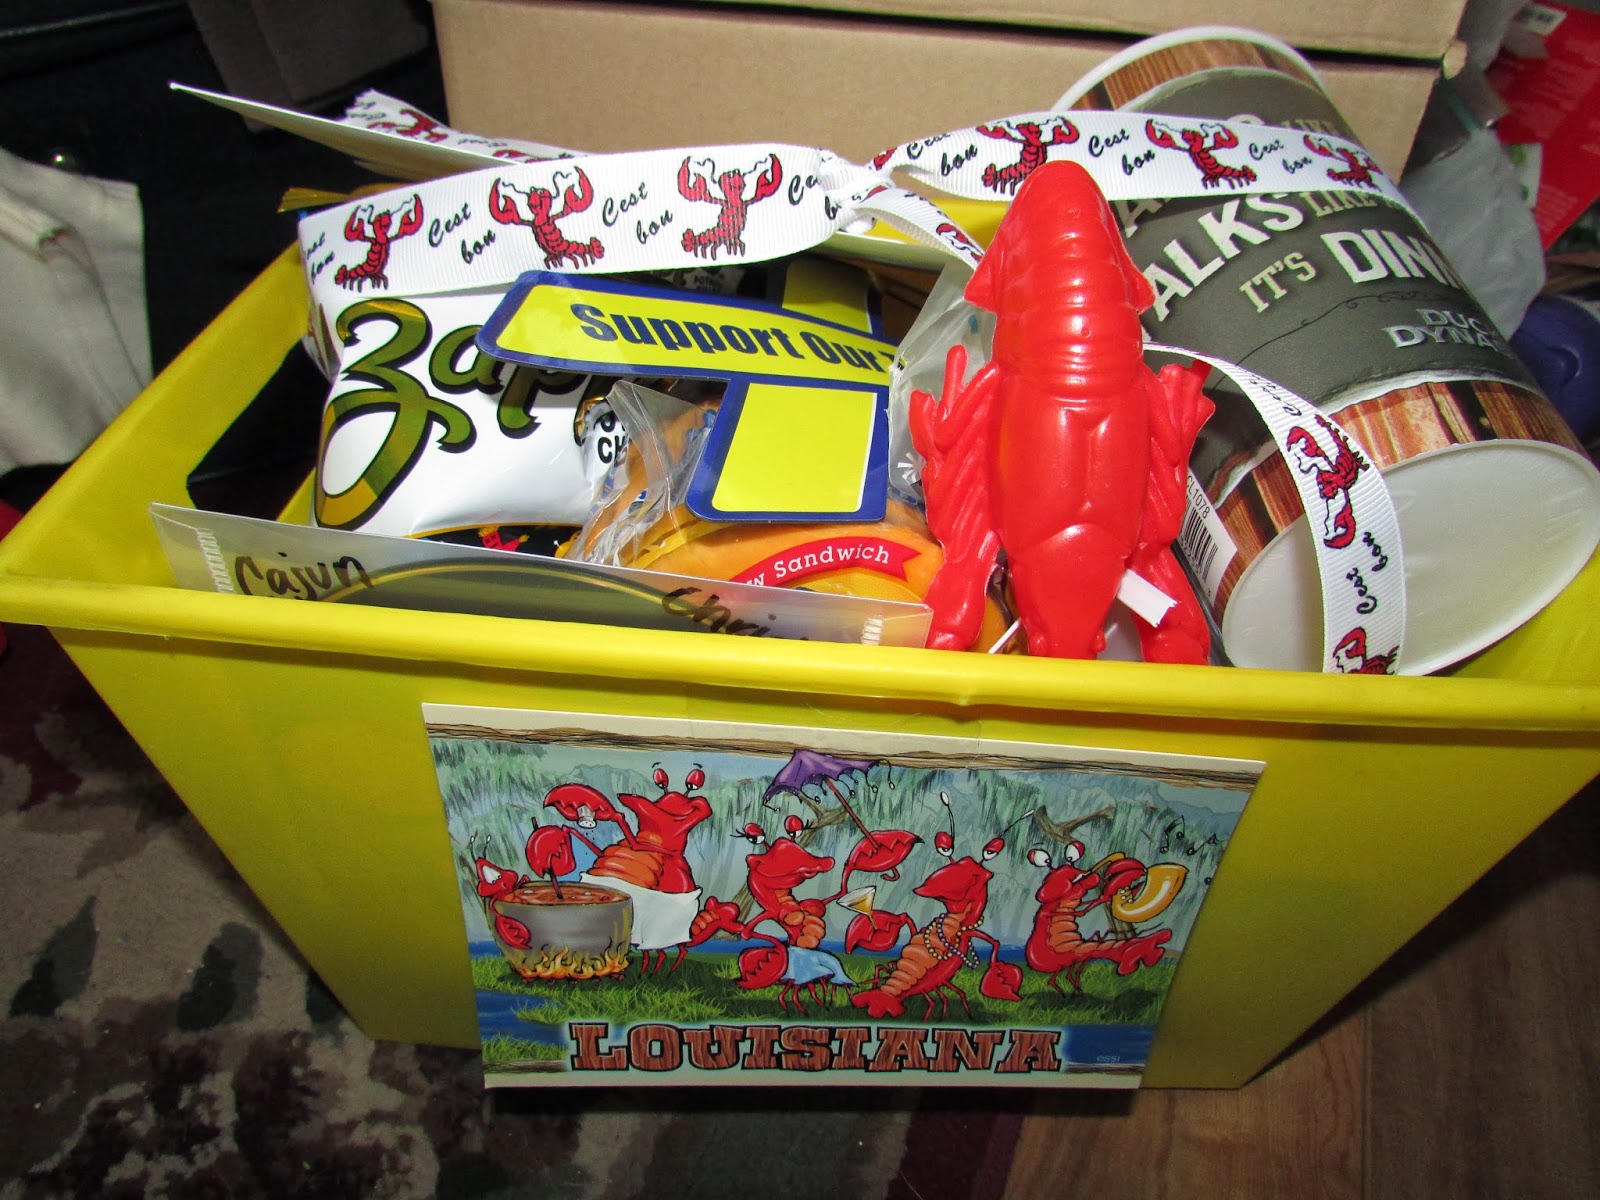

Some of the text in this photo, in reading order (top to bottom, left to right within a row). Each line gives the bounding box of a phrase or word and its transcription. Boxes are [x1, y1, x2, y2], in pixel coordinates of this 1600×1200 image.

[1142, 193, 1304, 340] ALKS
[1239, 251, 1316, 314] IT'S
[570, 303, 806, 361] Support
[799, 331, 887, 374] Our
[1381, 324, 1502, 353] DYNA
[1415, 308, 1496, 337] DUC
[234, 551, 375, 601] Cajun
[773, 544, 890, 579] Sandwich
[567, 1021, 1062, 1073] LOUISIANA
